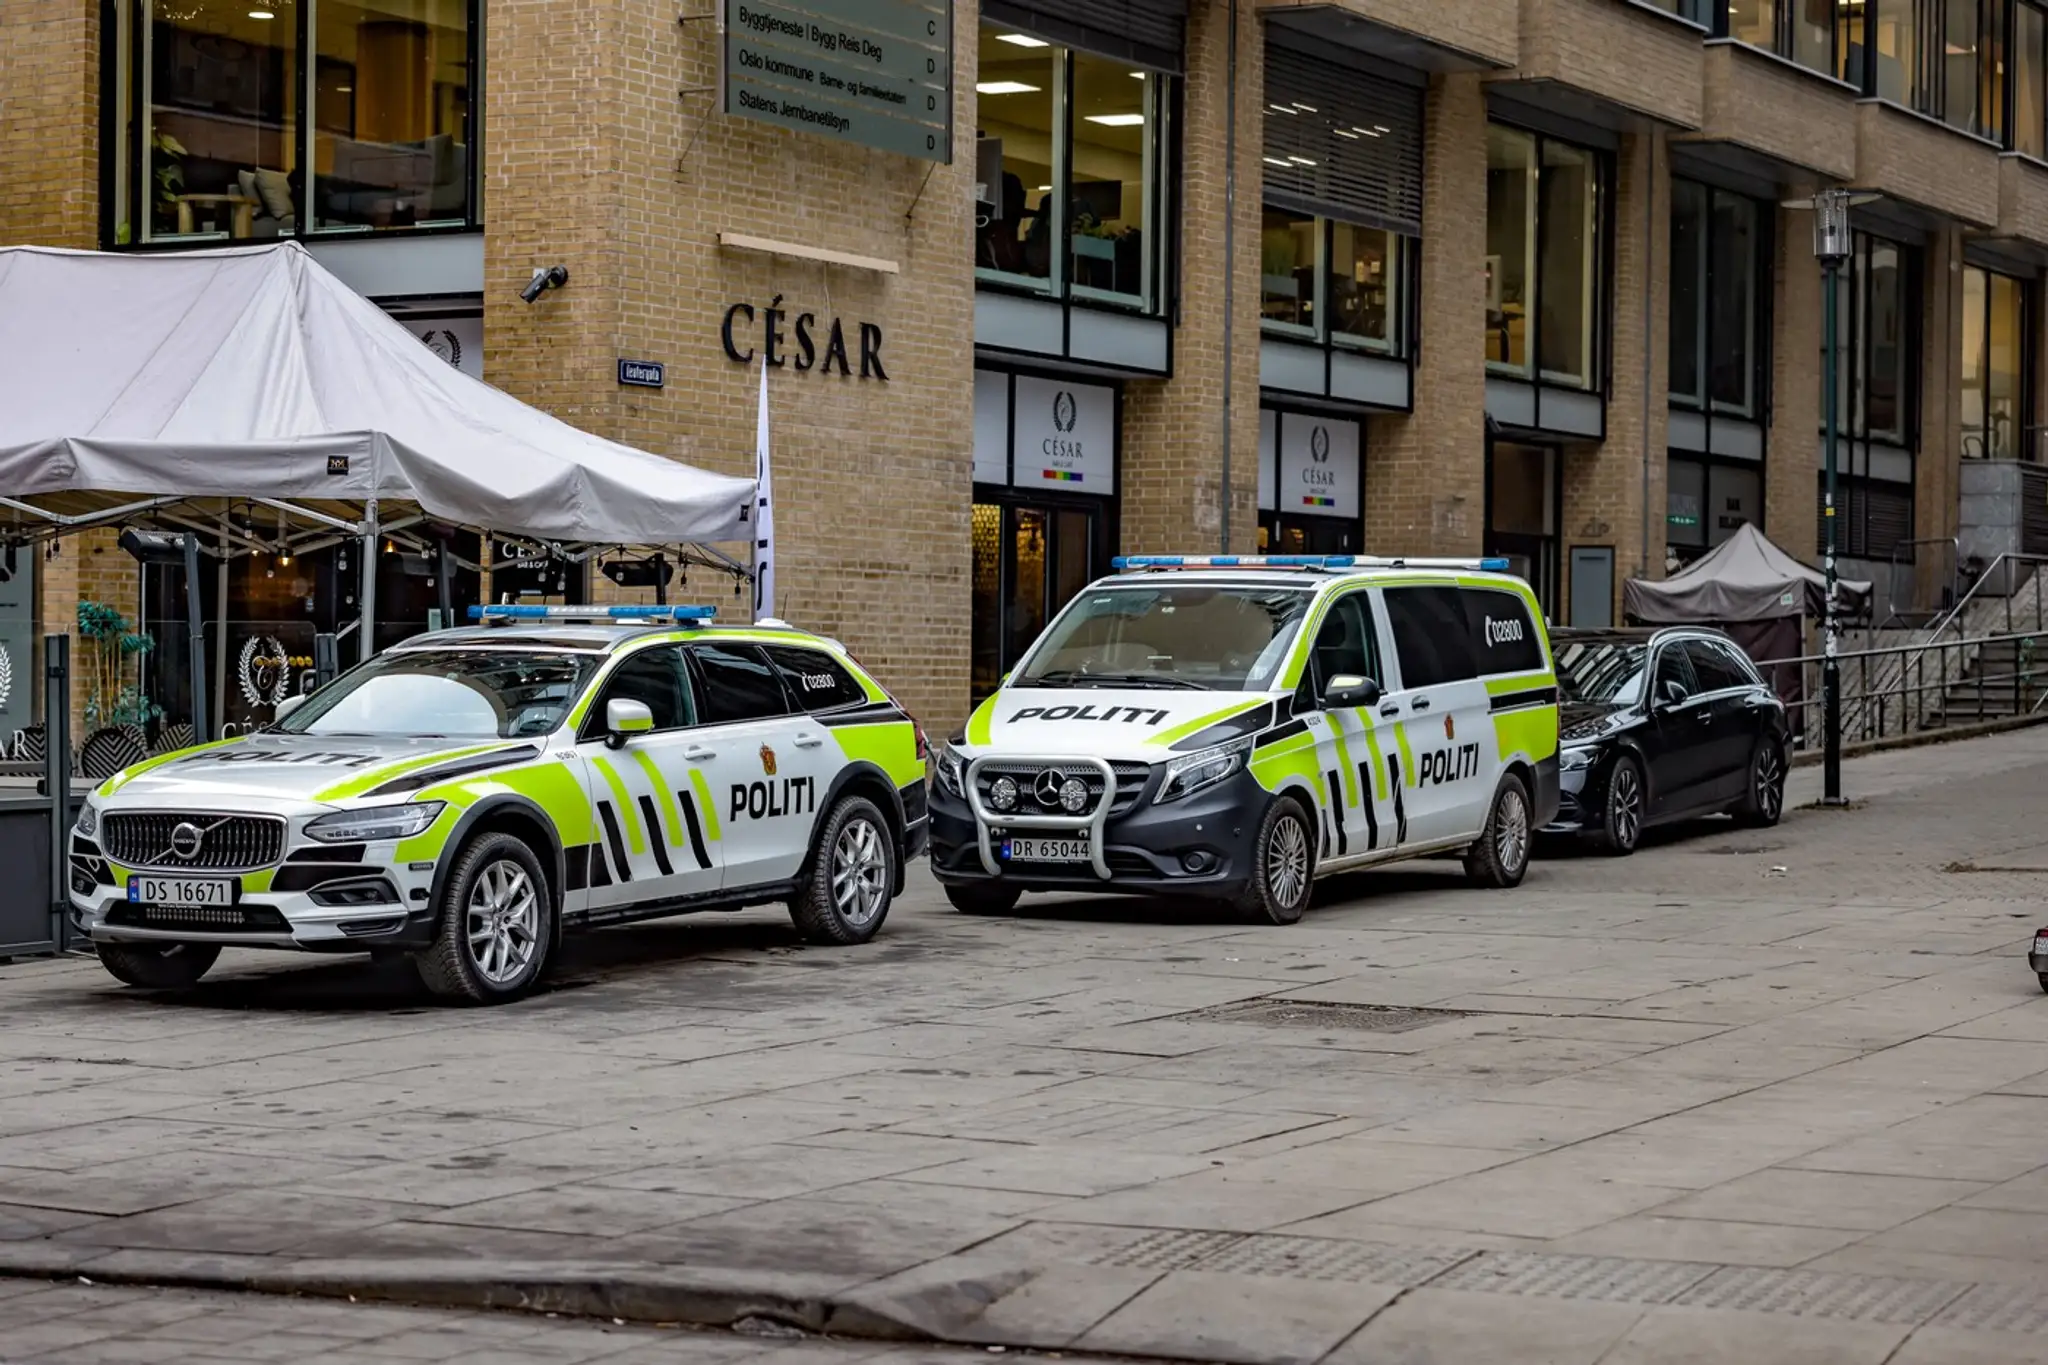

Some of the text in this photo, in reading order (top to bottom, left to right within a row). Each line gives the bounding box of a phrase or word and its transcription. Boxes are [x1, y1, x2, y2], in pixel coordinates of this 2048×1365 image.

[927, 20, 935, 36] C
[740, 6, 804, 38] Byggtjeneste
[811, 25, 836, 50] Bygg
[838, 33, 860, 53] Reis
[862, 40, 882, 62] Deg
[927, 58, 935, 74] D
[739, 49, 763, 69] Oslo
[765, 55, 814, 82] kommune
[847, 81, 857, 96] og
[927, 95, 936, 111] D
[739, 90, 935, 150] Statens Jernbanetilsyn D
[722, 294, 889, 381] CÉSAR
[1043, 436, 1083, 459] CÉSAR
[1302, 466, 1335, 486] CÉSAR
[1492, 619, 1522, 642] 02800
[807, 674, 835, 689] 02800
[1007, 705, 1170, 725] POLITI
[178, 751, 383, 767] POLITI
[1419, 743, 1479, 788] POLITI
[730, 776, 814, 821] POLITI
[1013, 841, 1089, 857] DR 65044
[146, 881, 224, 902] DS 16671
